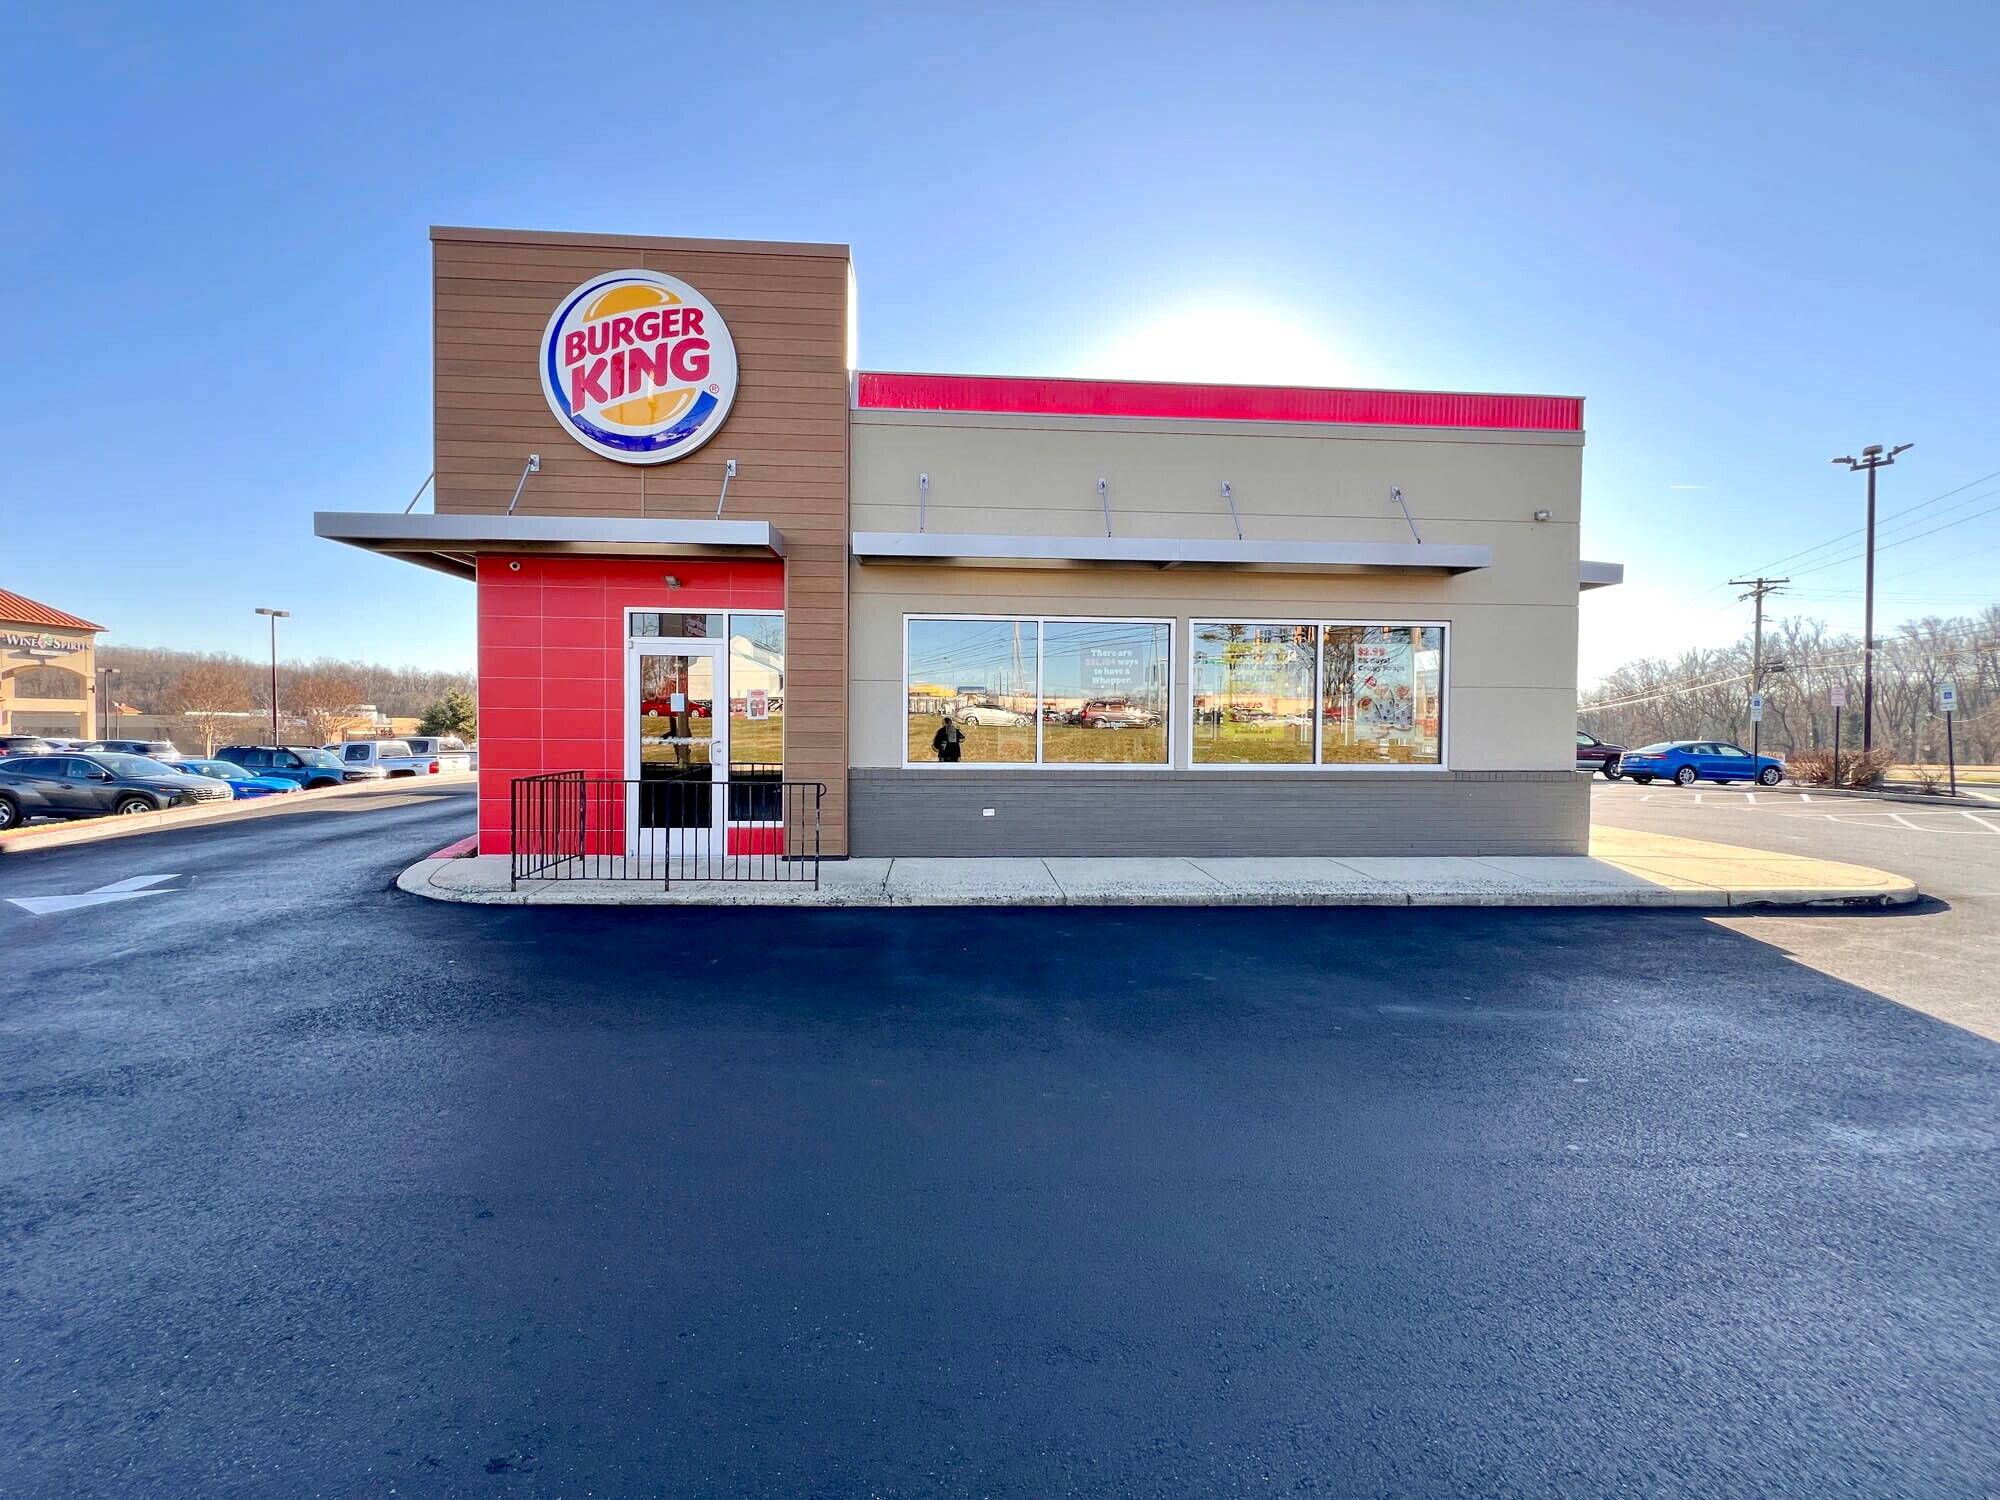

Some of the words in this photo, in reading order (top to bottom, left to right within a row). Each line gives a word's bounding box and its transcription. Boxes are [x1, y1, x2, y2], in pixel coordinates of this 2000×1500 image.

[565, 307, 705, 367] BURGER
[572, 338, 710, 414] KING
[6, 633, 38, 647] WINE
[53, 638, 90, 651] SPIRITS
[1091, 649, 1117, 657] There
[1118, 659, 1138, 667] ways
[1104, 666, 1123, 675] have
